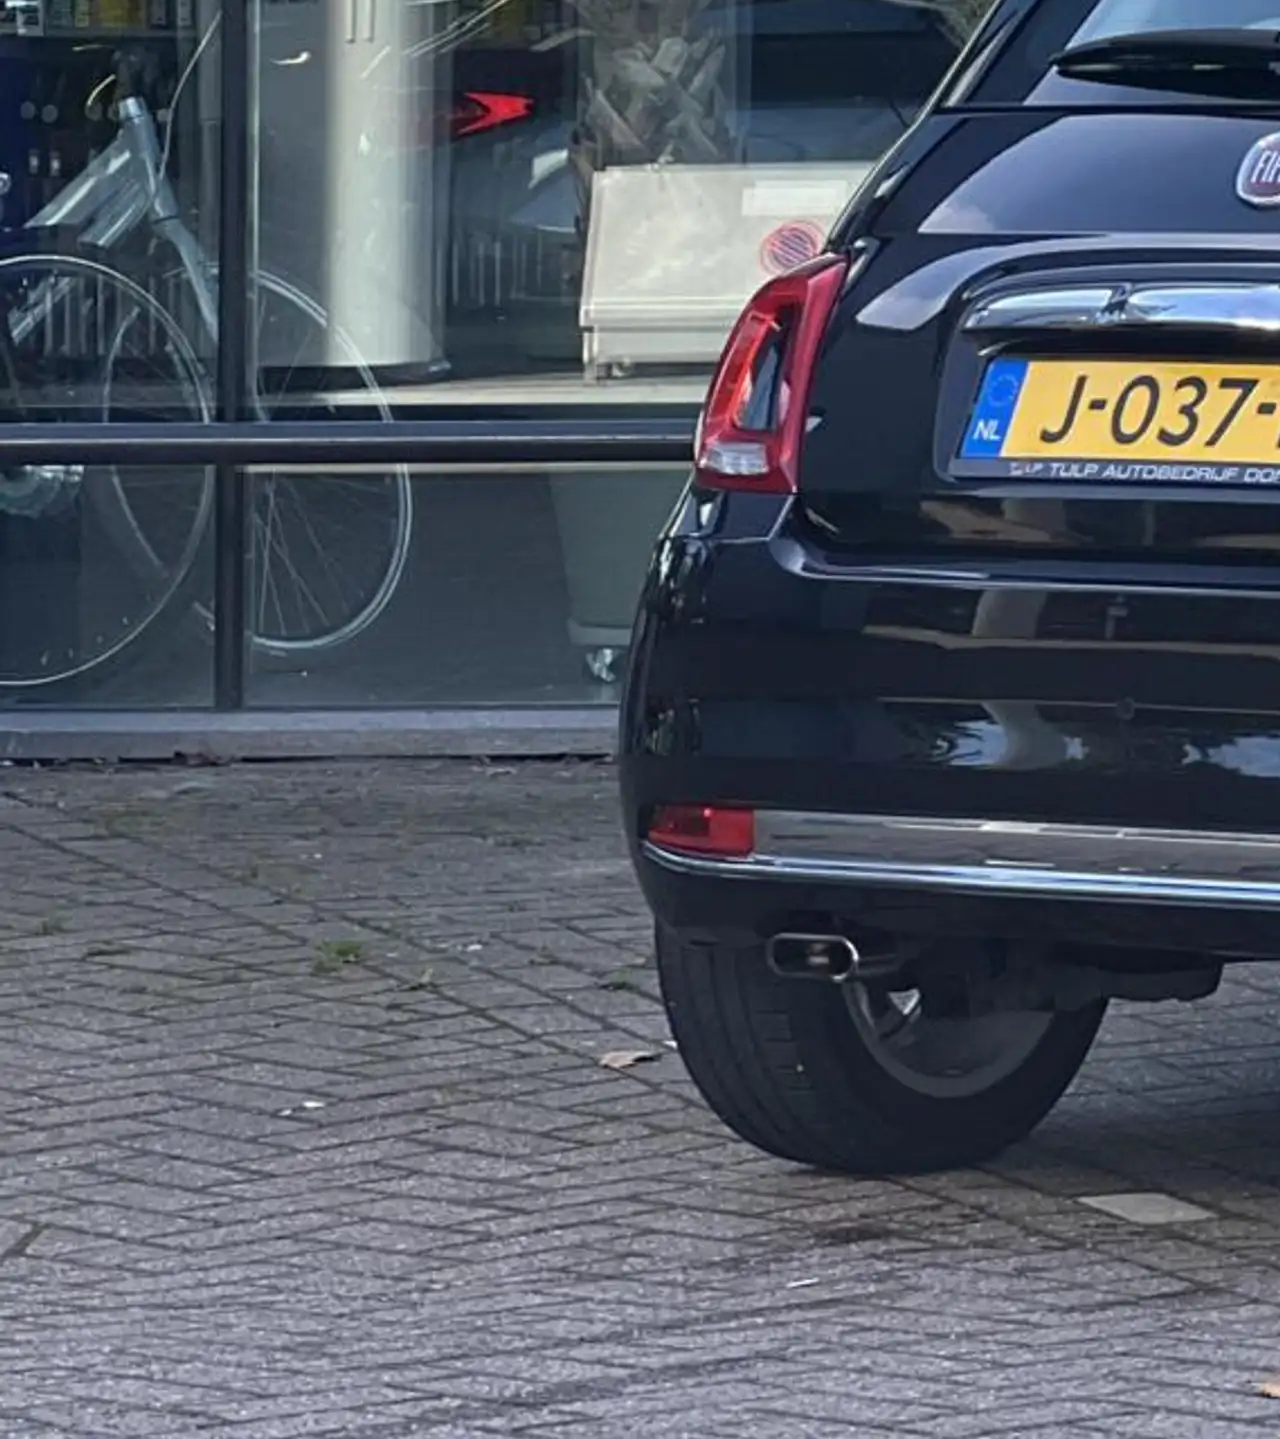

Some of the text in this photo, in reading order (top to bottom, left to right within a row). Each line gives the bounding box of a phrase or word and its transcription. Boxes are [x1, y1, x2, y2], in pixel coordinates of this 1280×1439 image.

[973, 418, 1001, 441] NL
[1050, 461, 1098, 479] TULP
[1102, 464, 1239, 483] AUTOBEDRIJF
